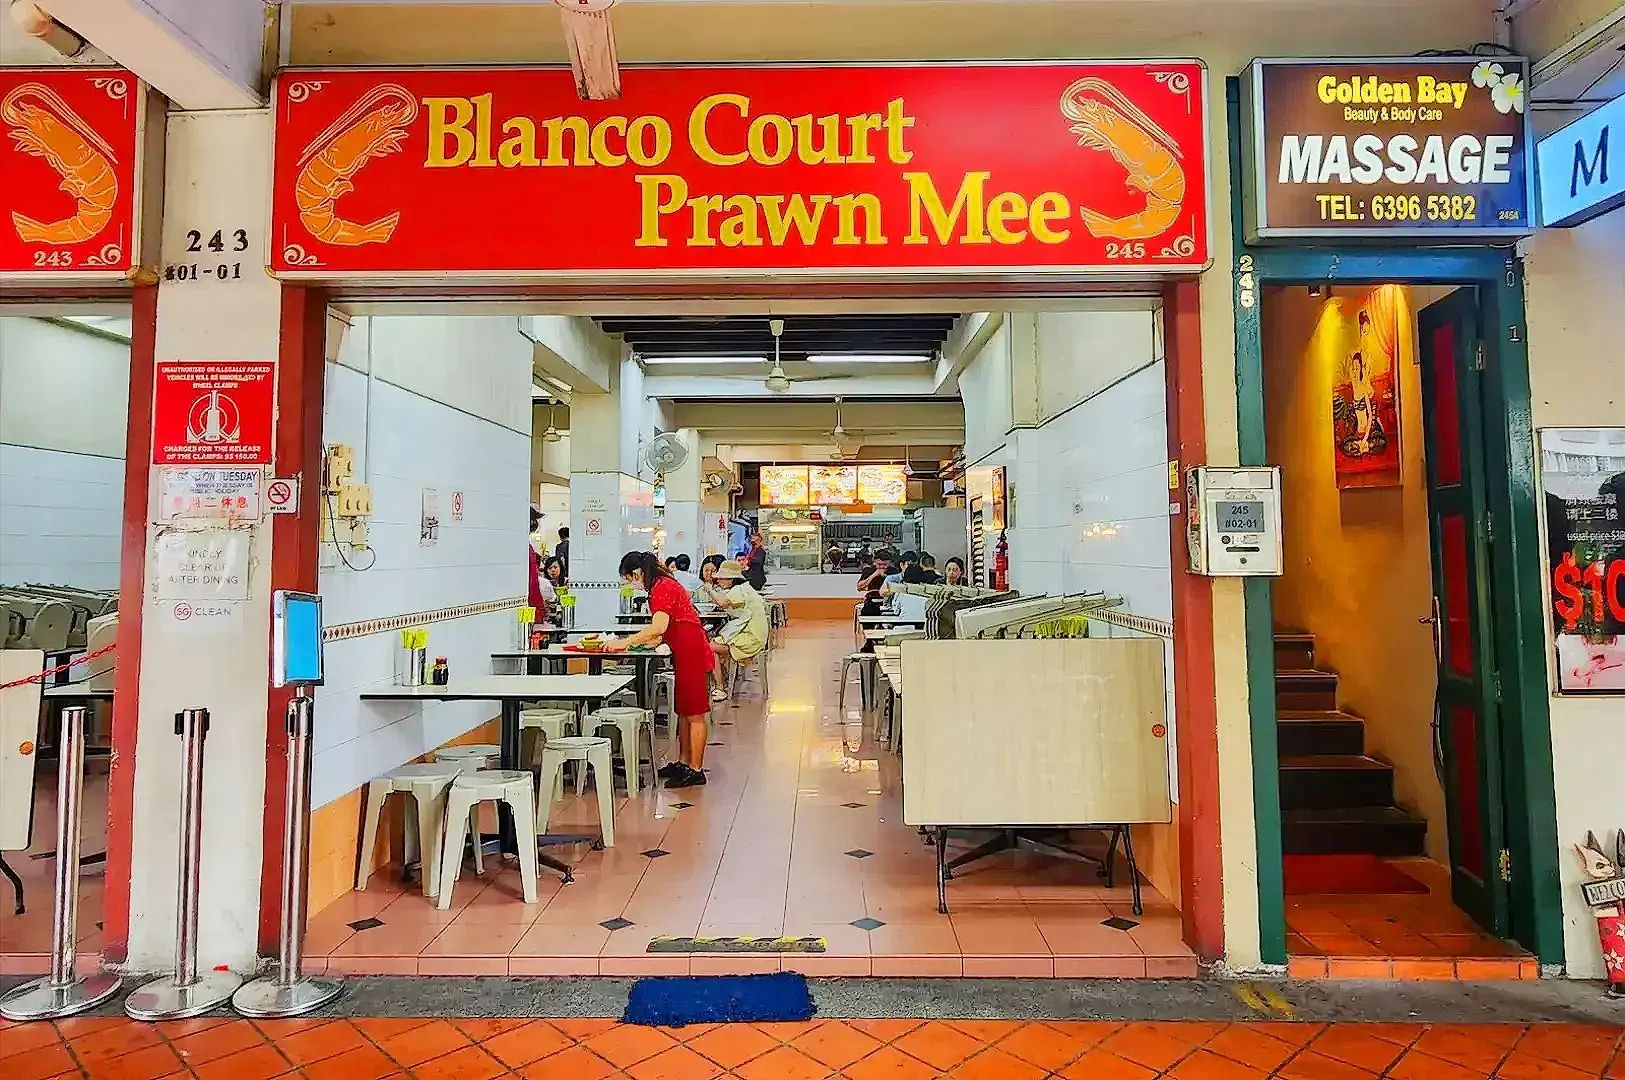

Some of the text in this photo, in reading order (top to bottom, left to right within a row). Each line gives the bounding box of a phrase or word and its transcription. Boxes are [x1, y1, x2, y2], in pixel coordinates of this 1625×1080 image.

[1317, 75, 1468, 109] Golden Bay
[1344, 107, 1443, 124] Beauty & Body Care
[421, 92, 916, 168] Blanco Court
[1278, 134, 1514, 185] MASSAGE
[634, 171, 1072, 247] Prawn Mee
[1315, 195, 1476, 220] TEL: 6396 5382
[34, 250, 73, 267] 243
[1105, 243, 1146, 259] 245
[1238, 254, 1255, 308] 245
[1231, 505, 1249, 515] 245
[176, 607, 231, 616] SG CLEAN
